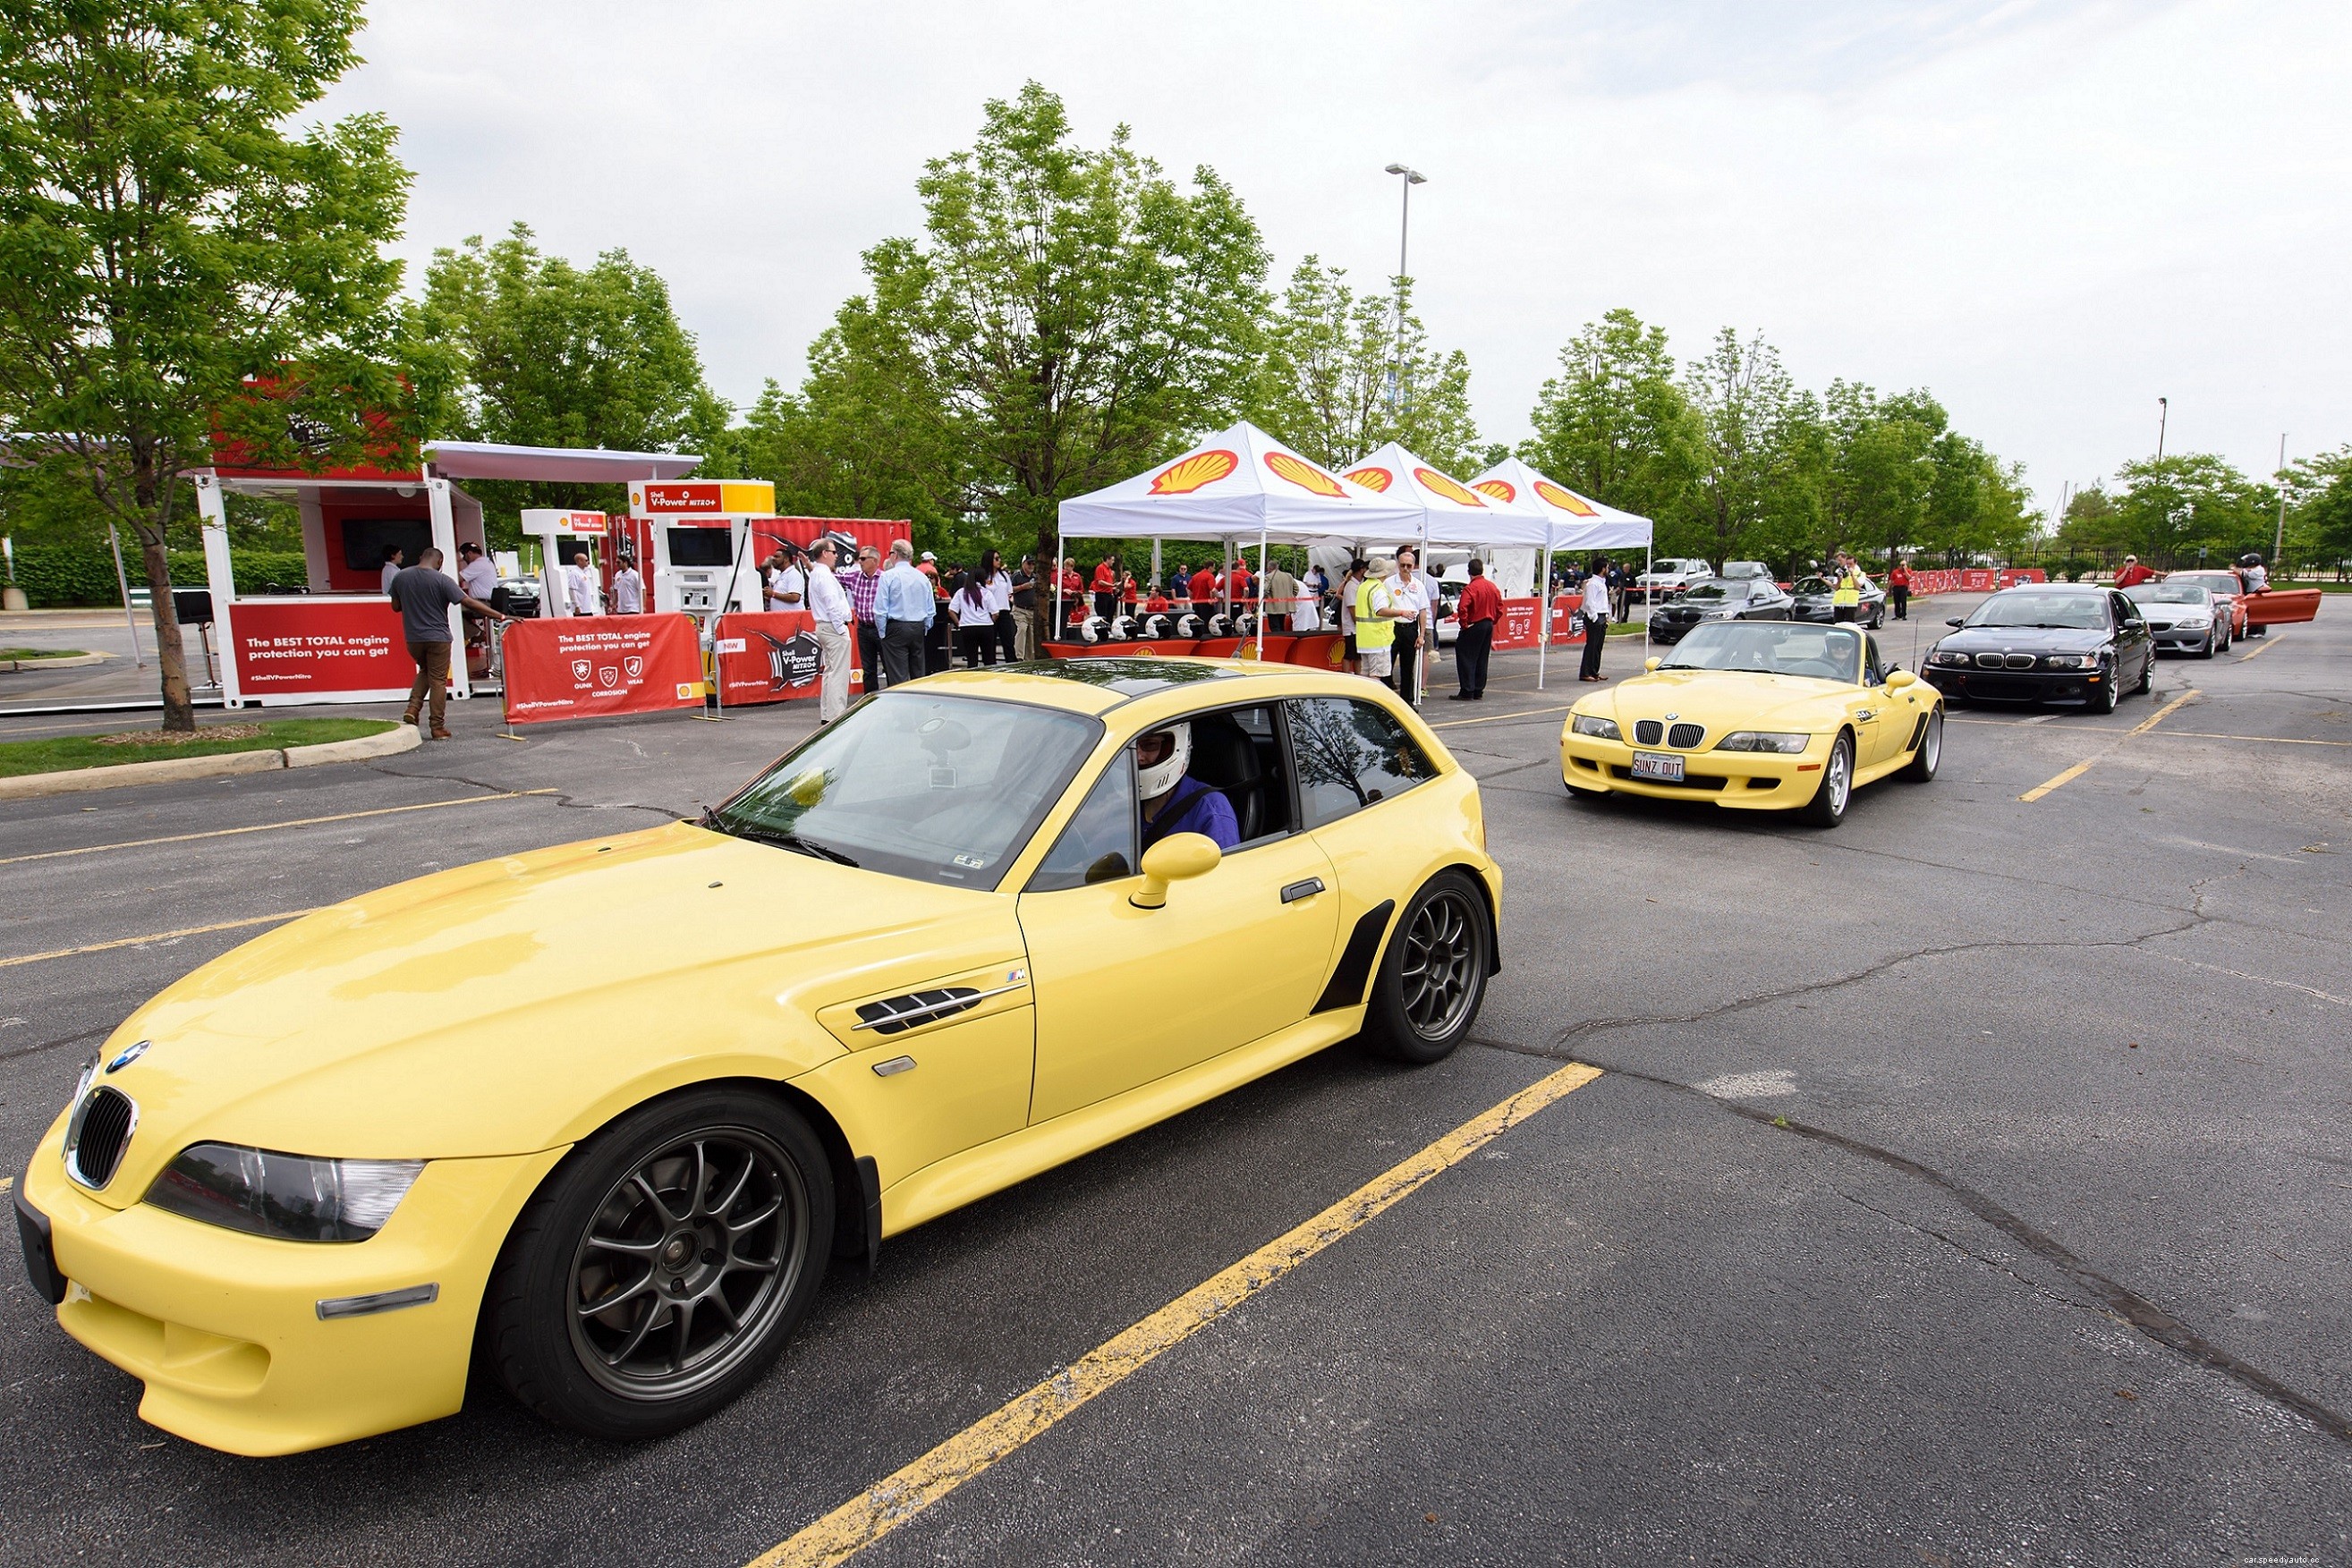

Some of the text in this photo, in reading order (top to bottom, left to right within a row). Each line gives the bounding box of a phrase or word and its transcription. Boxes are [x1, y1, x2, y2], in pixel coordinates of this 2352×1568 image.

[650, 497, 687, 506] V-Power
[246, 635, 390, 648] The BEST TOTAL engine
[558, 631, 650, 643] The BEST TOTAL engine
[559, 640, 650, 654] protection you can get
[249, 648, 389, 661] protection you can get
[783, 655, 816, 665] V-Power
[250, 674, 312, 682] #ShellVPowerNitro
[591, 689, 628, 698] CORROSION
[516, 699, 574, 709] #ShellVPowerNitro
[1634, 759, 1681, 776] SUNZ OUT
